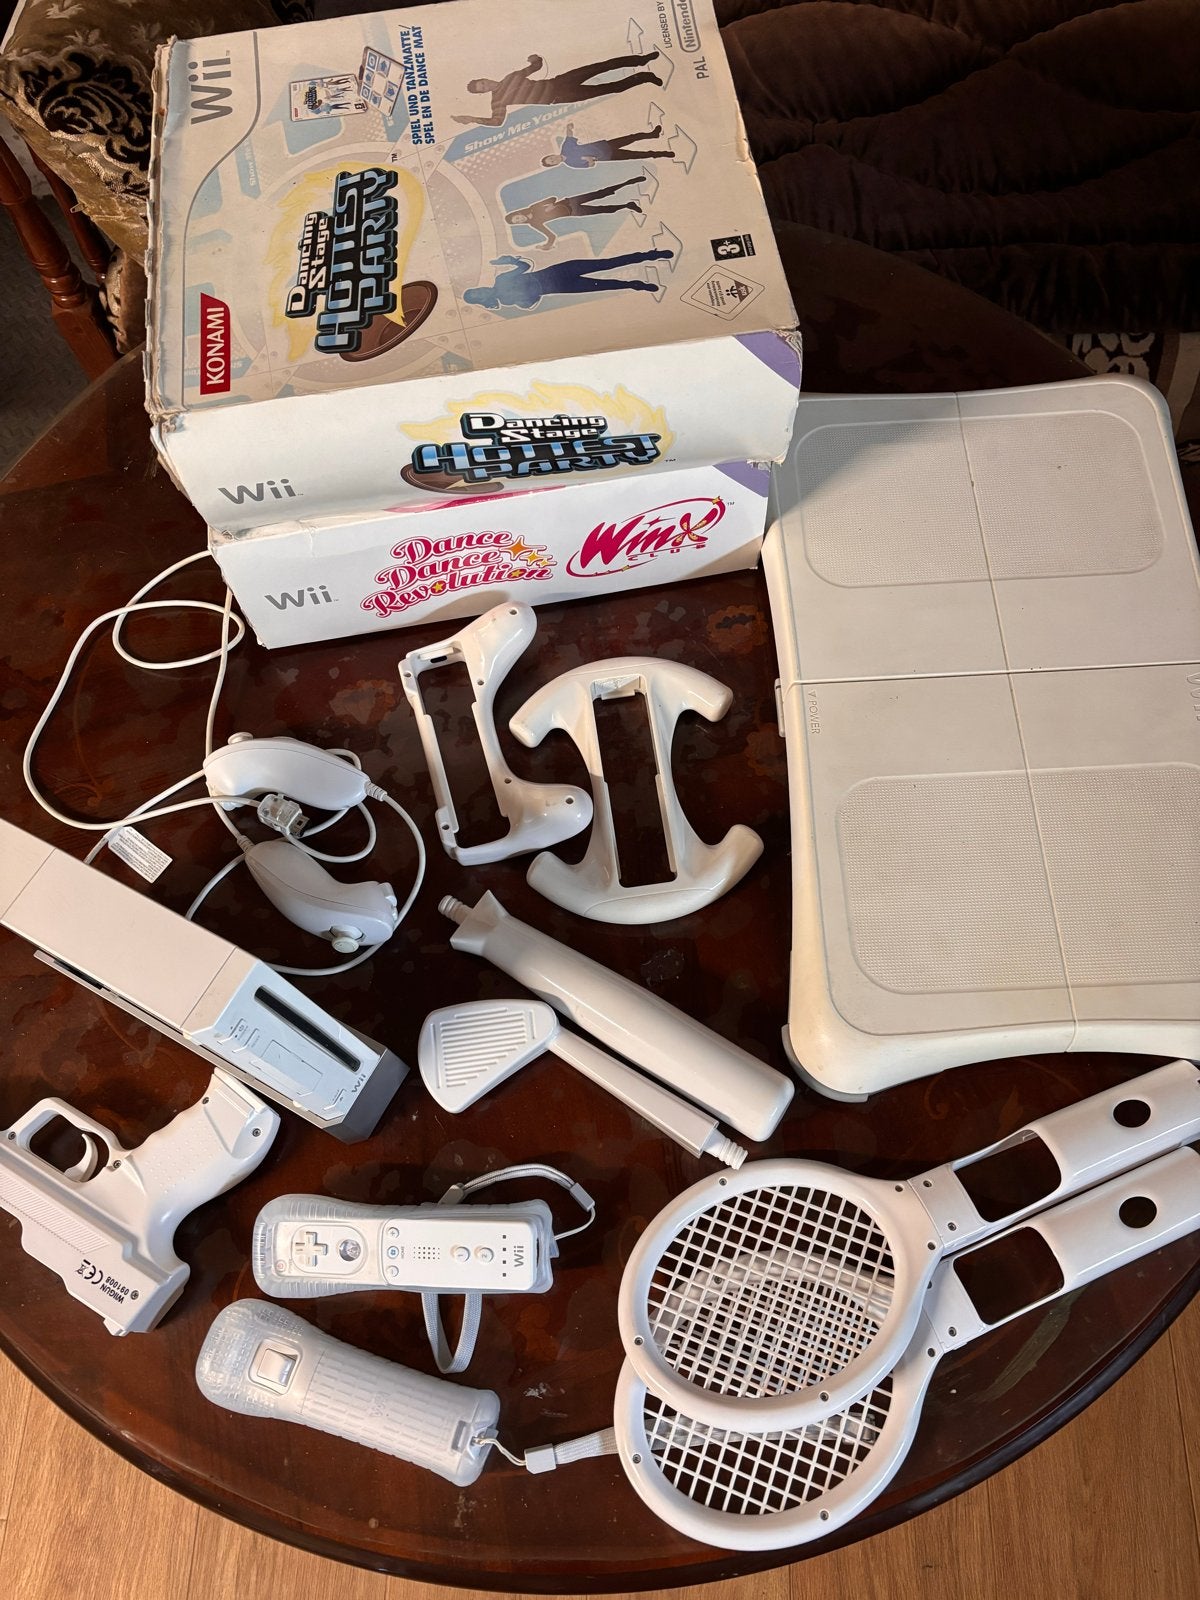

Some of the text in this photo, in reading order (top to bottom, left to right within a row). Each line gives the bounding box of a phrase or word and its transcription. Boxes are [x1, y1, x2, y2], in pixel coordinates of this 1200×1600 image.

[656, 1, 673, 49] LICENSED BY
[412, 26, 436, 145] SPEL EN DE DANCE MAT
[693, 56, 710, 80] PAL
[188, 57, 233, 125] Wii
[408, 94, 420, 117] UND
[410, 118, 423, 145] SPIEL
[464, 131, 507, 153] Show
[507, 120, 533, 136] Me
[531, 104, 571, 126] Your
[308, 217, 331, 291] Stage
[358, 169, 389, 309] PARTY
[289, 212, 319, 312] Dancing
[317, 173, 362, 348] HOTTEST
[206, 306, 225, 386] KONAMI
[469, 413, 606, 431] Dancing
[500, 427, 599, 444] Stage
[420, 435, 653, 475] HOTTEST
[468, 448, 658, 479] PARTY
[218, 478, 297, 505] Wii
[391, 530, 514, 565] Dance
[579, 507, 719, 569] Winx
[376, 550, 502, 591] Dance
[263, 585, 333, 611] Wii
[360, 564, 553, 618] Revolution
[808, 700, 821, 734] POWER
[351, 1073, 366, 1093] Wii
[513, 1245, 525, 1268] Wii
[105, 1276, 130, 1296] 091008
